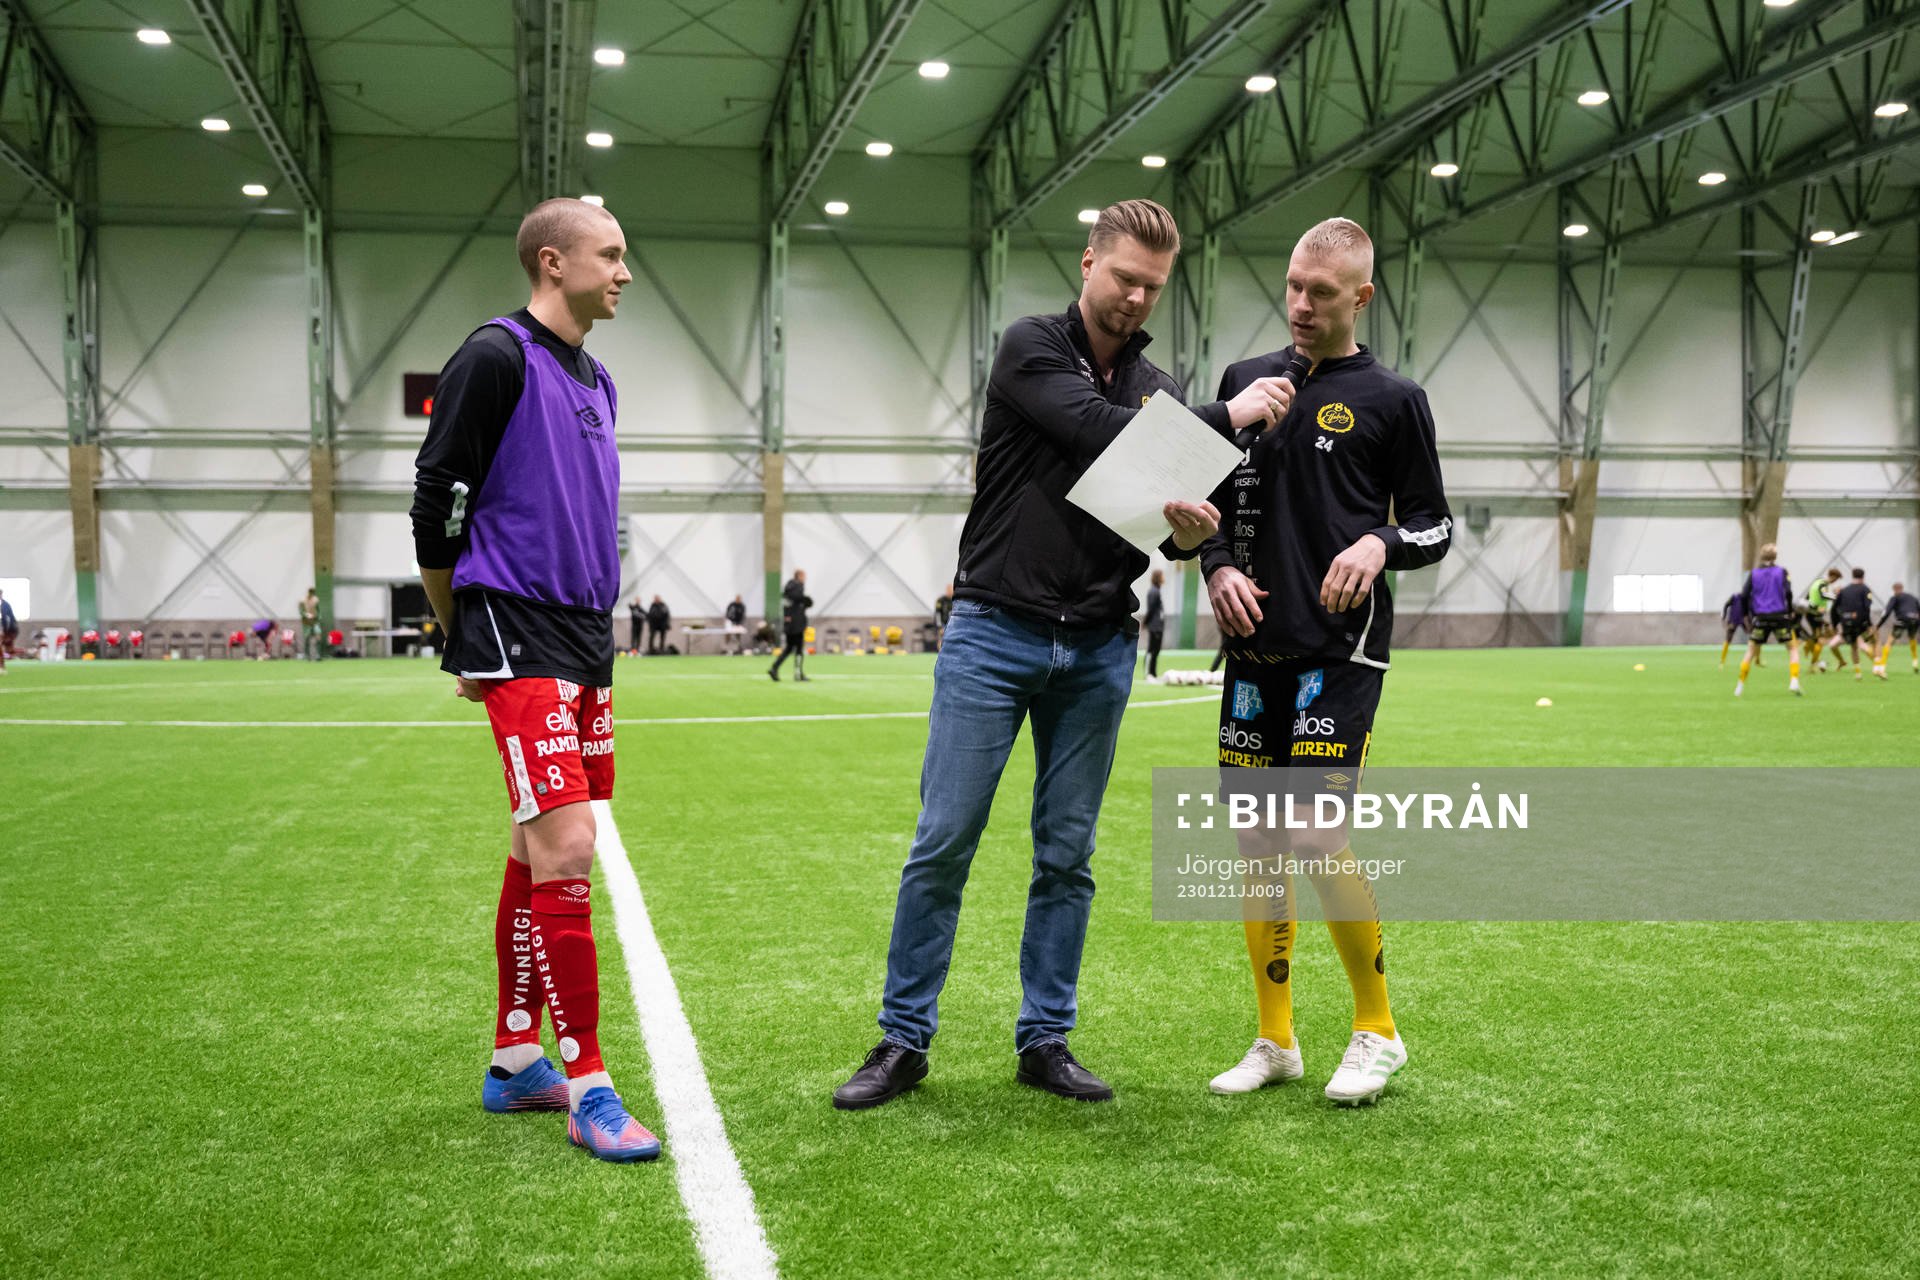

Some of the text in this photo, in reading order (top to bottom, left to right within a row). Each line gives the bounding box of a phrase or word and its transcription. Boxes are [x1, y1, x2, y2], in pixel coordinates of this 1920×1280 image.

[1315, 436, 1334, 452] 24
[1219, 721, 1262, 749] ellos
[1293, 710, 1335, 736] ellos
[546, 764, 565, 790] 8
[1326, 783, 1348, 791] umbro
[513, 908, 532, 1005] VINNERGI
[531, 925, 568, 1032] VINNERGI
